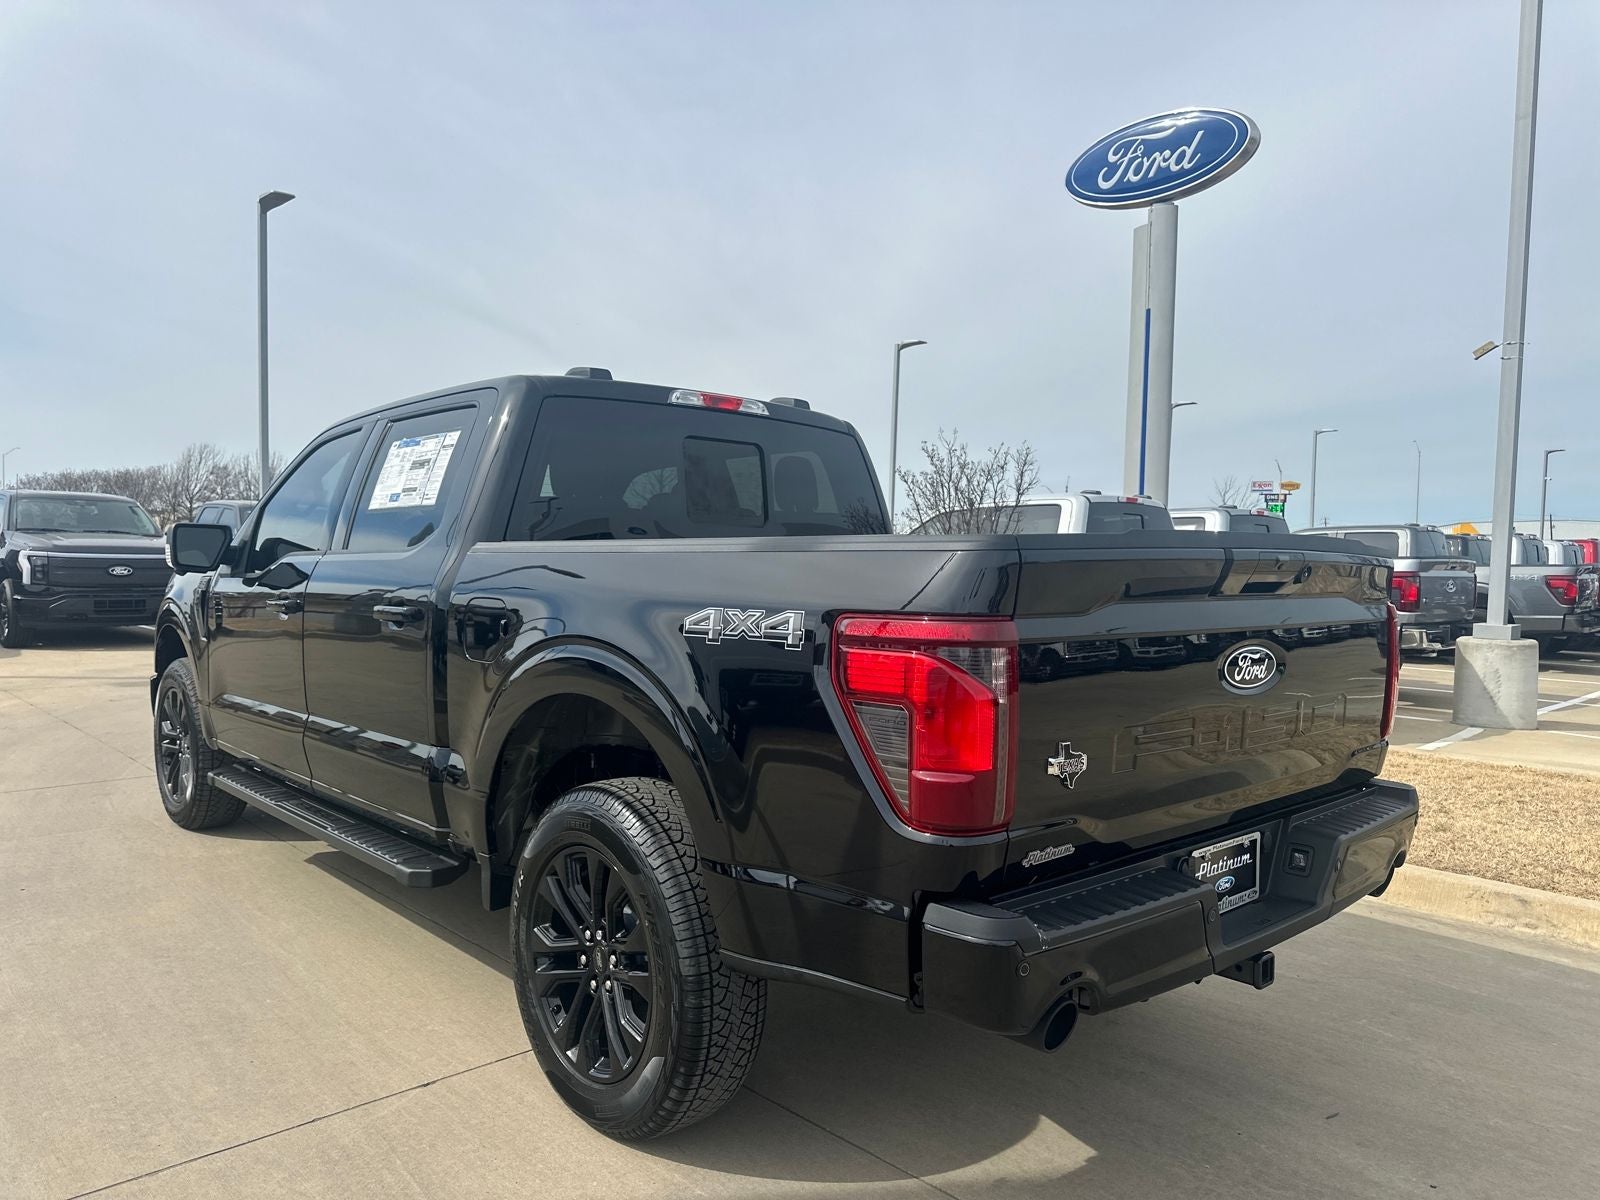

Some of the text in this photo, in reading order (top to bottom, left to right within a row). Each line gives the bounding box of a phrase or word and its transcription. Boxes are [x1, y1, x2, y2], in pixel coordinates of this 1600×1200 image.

[1097, 126, 1204, 190] Ford
[1234, 652, 1269, 681] Ford
[1056, 758, 1086, 774] TEXAS
[1022, 843, 1075, 867] Platinum
[1195, 853, 1253, 880] Platinum
